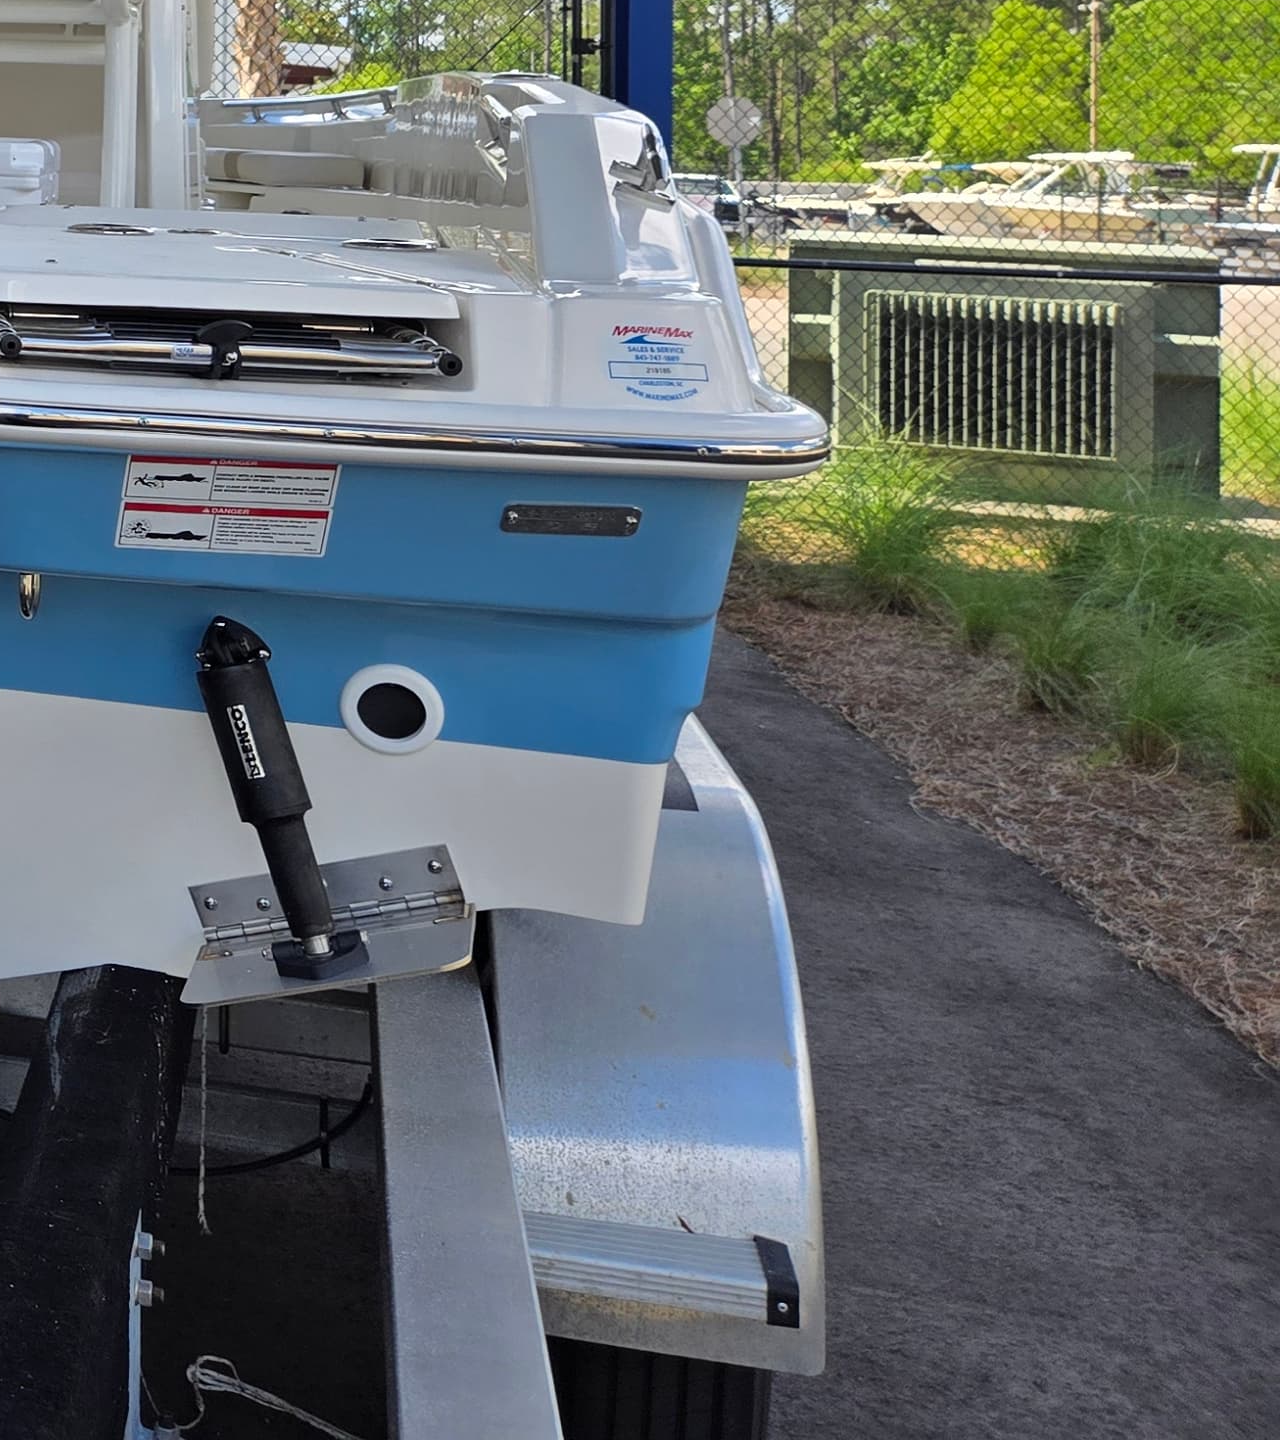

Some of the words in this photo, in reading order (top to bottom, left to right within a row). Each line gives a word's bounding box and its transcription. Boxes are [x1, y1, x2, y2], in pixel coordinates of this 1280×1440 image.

[627, 345, 649, 353] SALES
[656, 346, 685, 354] SERVICE
[211, 507, 251, 515] DANGER
[230, 706, 258, 764] LENCO
